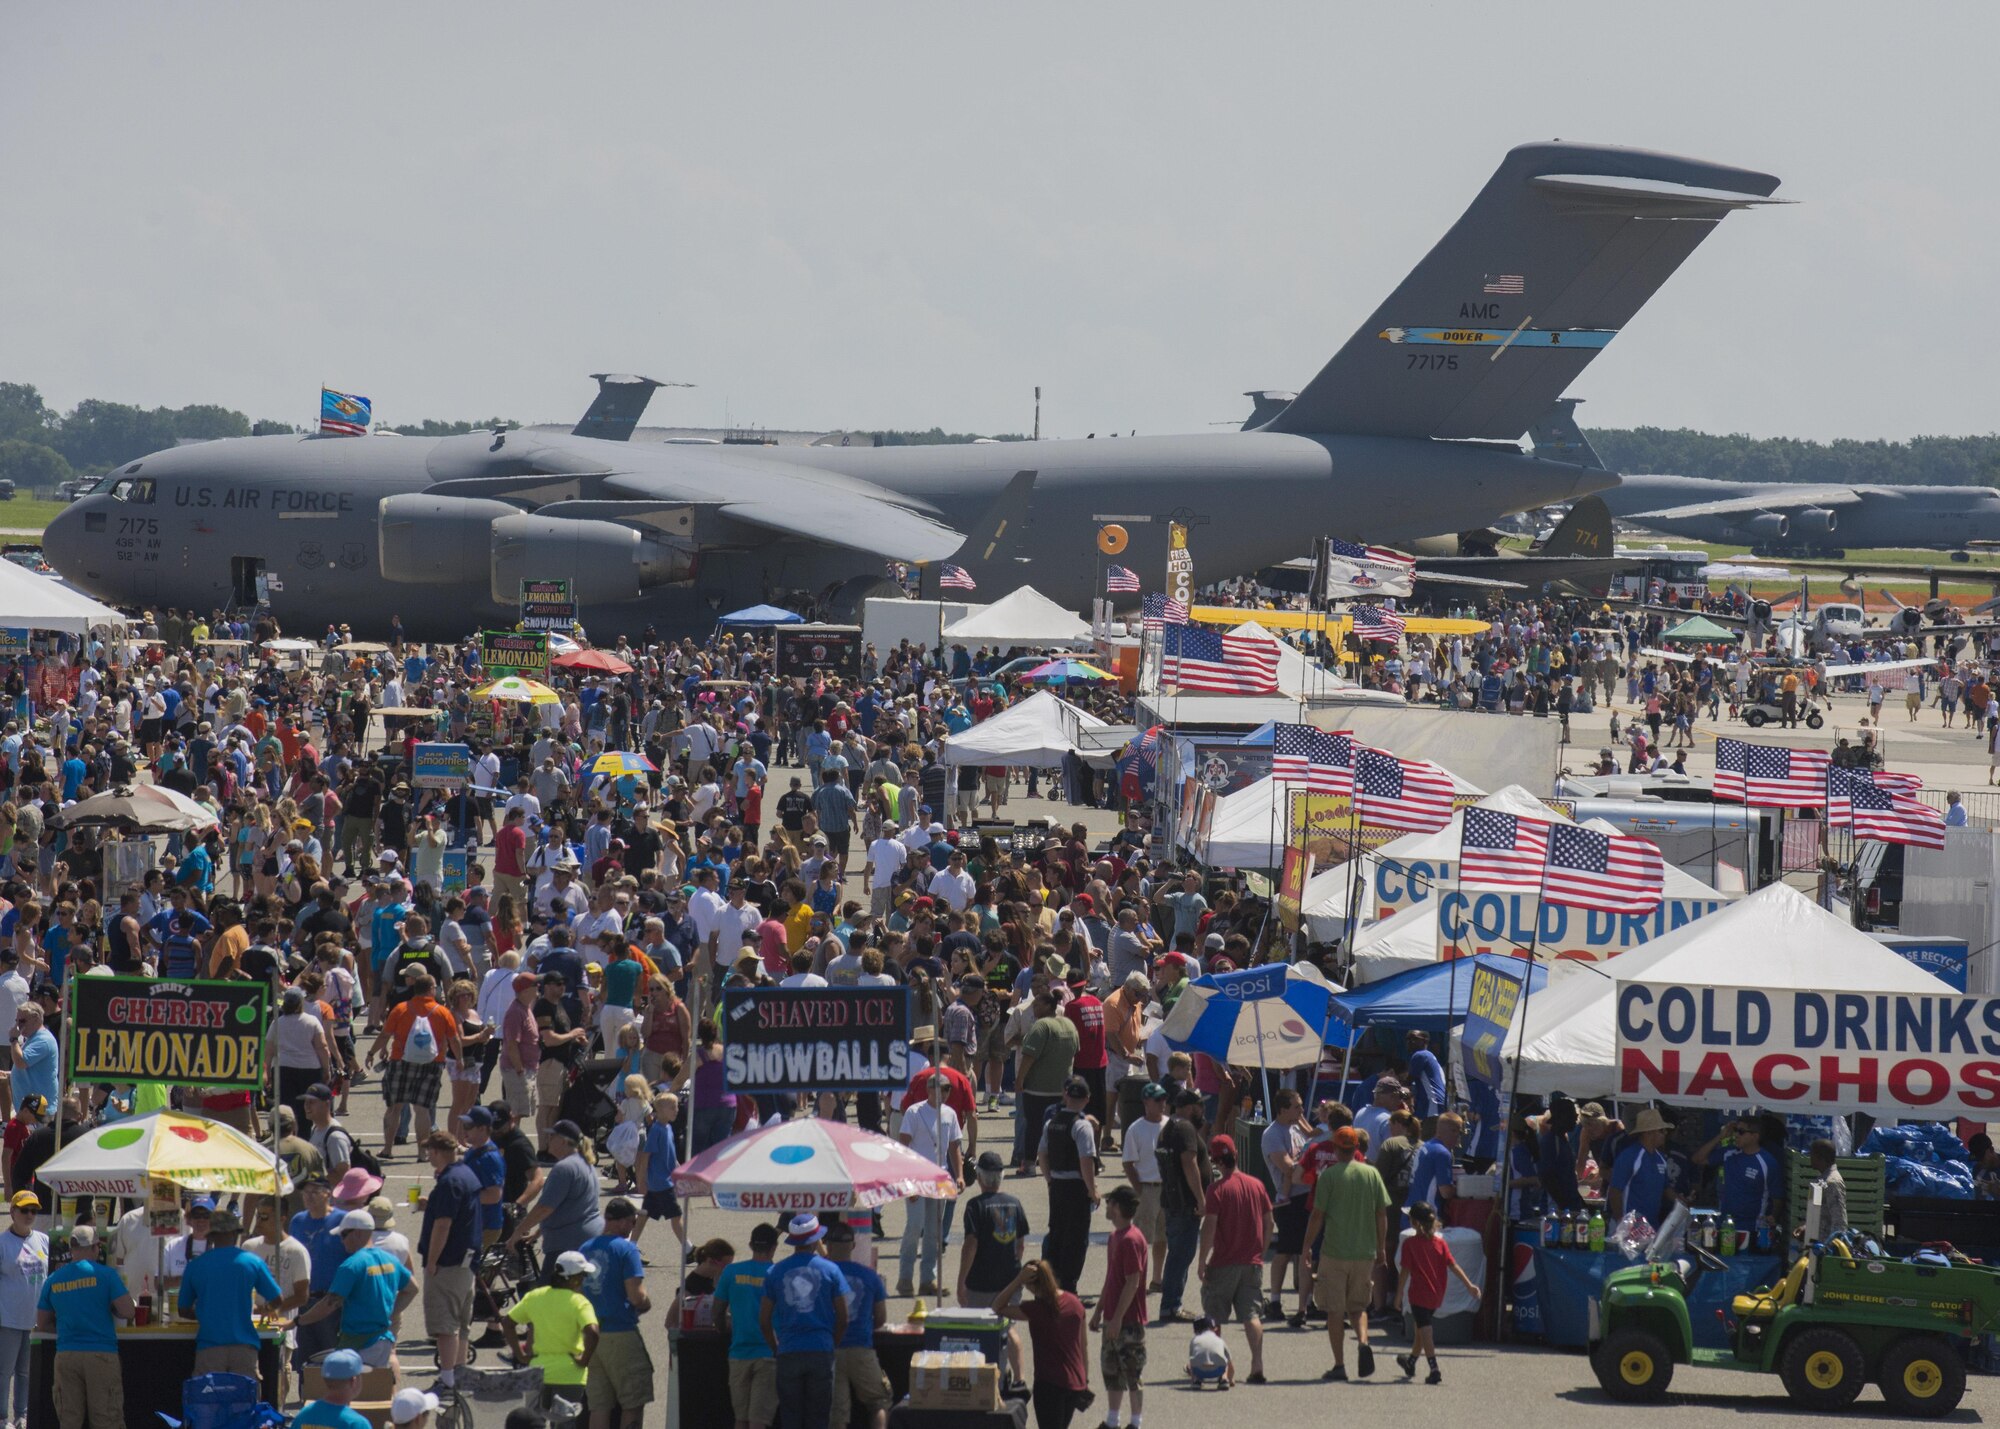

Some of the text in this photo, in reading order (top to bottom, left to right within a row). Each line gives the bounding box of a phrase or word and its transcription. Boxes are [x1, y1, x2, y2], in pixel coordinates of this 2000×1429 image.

[1459, 303, 1500, 319] AMC
[1442, 332, 1484, 342] DOVER
[1407, 354, 1459, 370] 77175
[175, 487, 354, 512] U.S. AIR FORCE
[118, 518, 158, 535] 7175
[147, 538, 162, 549] AW
[1576, 528, 1599, 549] 774
[143, 551, 159, 562] AW
[524, 592, 565, 603] LEMONADE
[494, 638, 536, 650] CHERRY
[484, 648, 545, 669] LEMONADE
[417, 756, 468, 767] Smoothies
[1440, 891, 1567, 945] COLD
[1921, 950, 1963, 973] RECYCLE
[149, 982, 194, 997] JERRY'S
[108, 996, 230, 1029] CHERRY
[730, 997, 895, 1029] NEW SHAVED ICE
[1618, 984, 2000, 1056] COLD DRINKS
[76, 1027, 259, 1080] LEMONADE
[726, 1039, 908, 1085] SNOWBALLS
[1621, 1047, 2000, 1108] NACHOS
[58, 1178, 137, 1195] LEMONADE
[740, 1191, 849, 1209] SHAVED ICE
[51, 1276, 97, 1293] VOLUNTEER
[1823, 1291, 1850, 1301] JOHN
[1853, 1294, 1885, 1304] DEERE
